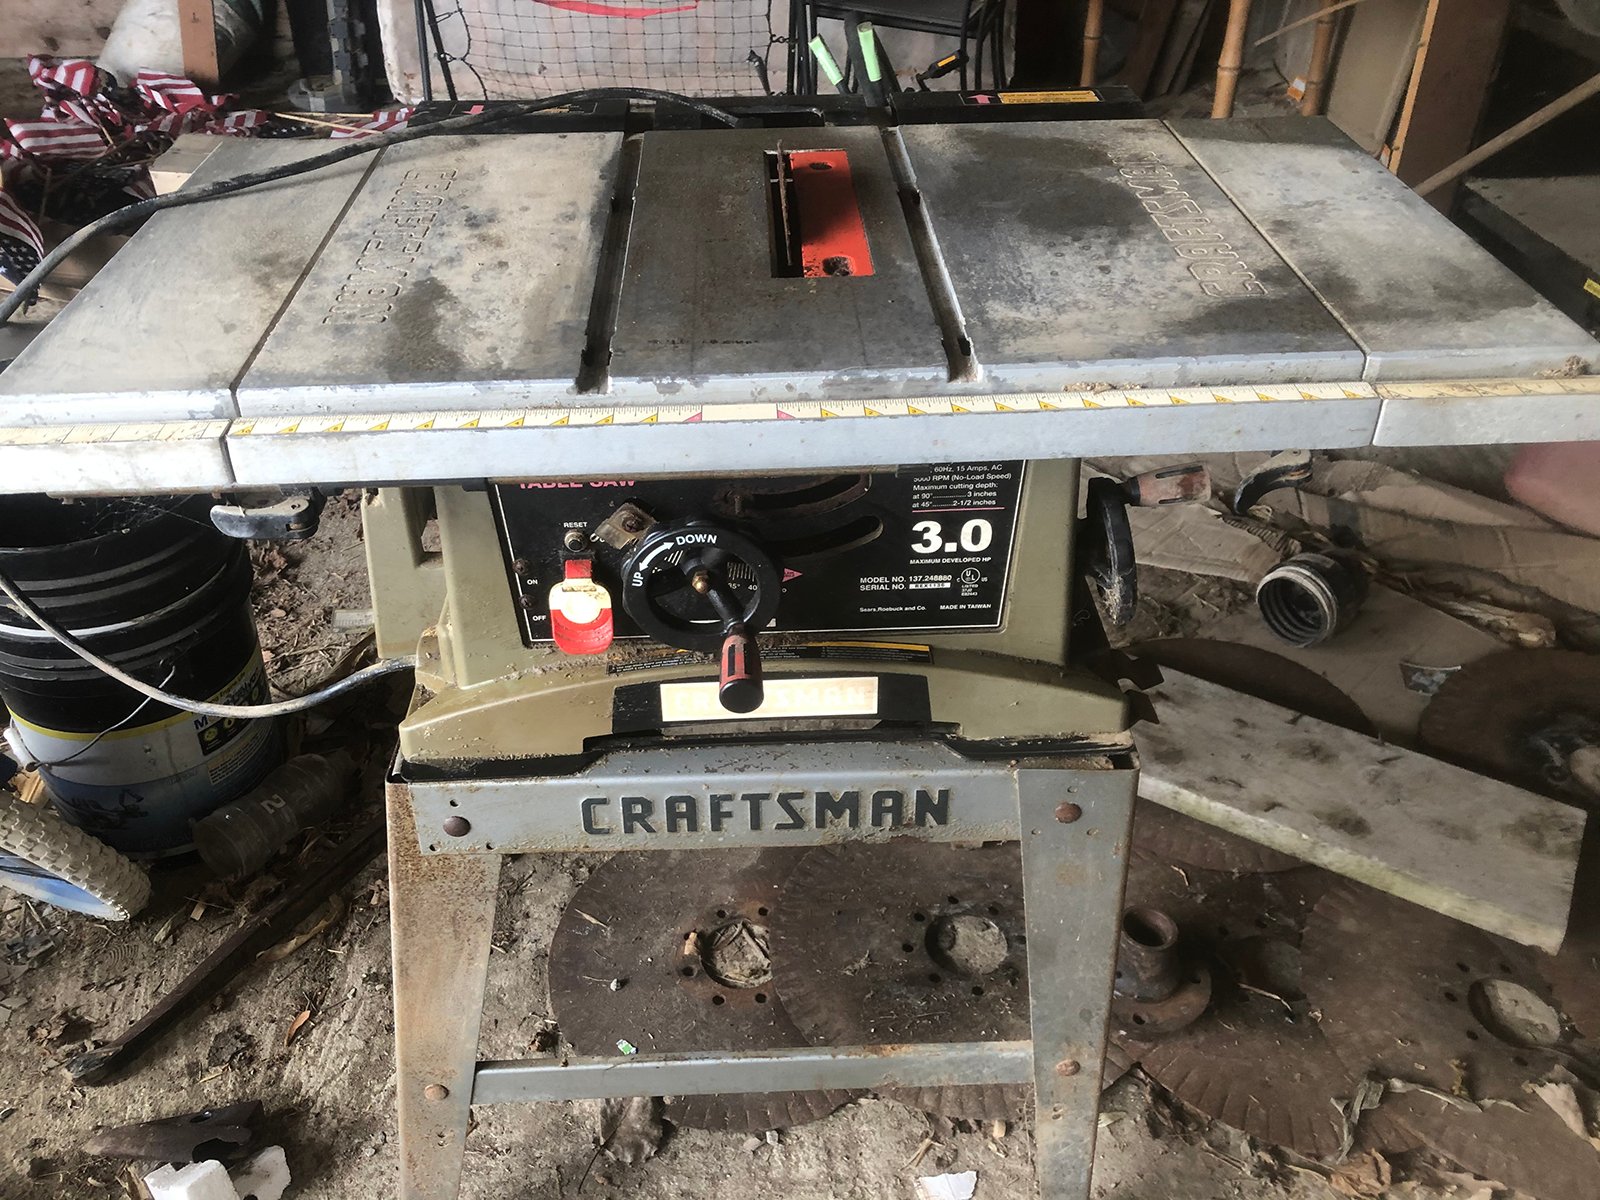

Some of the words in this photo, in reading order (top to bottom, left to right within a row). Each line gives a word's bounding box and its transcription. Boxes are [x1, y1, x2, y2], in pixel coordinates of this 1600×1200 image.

[986, 472, 1012, 481] Speed)
[973, 490, 997, 498] inches
[972, 498, 996, 506] inches
[675, 533, 717, 546] DOWN
[910, 518, 993, 554] 3.0
[631, 571, 645, 588] UP
[859, 576, 890, 584] MODEL
[891, 575, 907, 583] NO.
[859, 583, 890, 591] SERIAL
[532, 614, 547, 622] OFF
[580, 788, 950, 836] CRAFTSMAN
